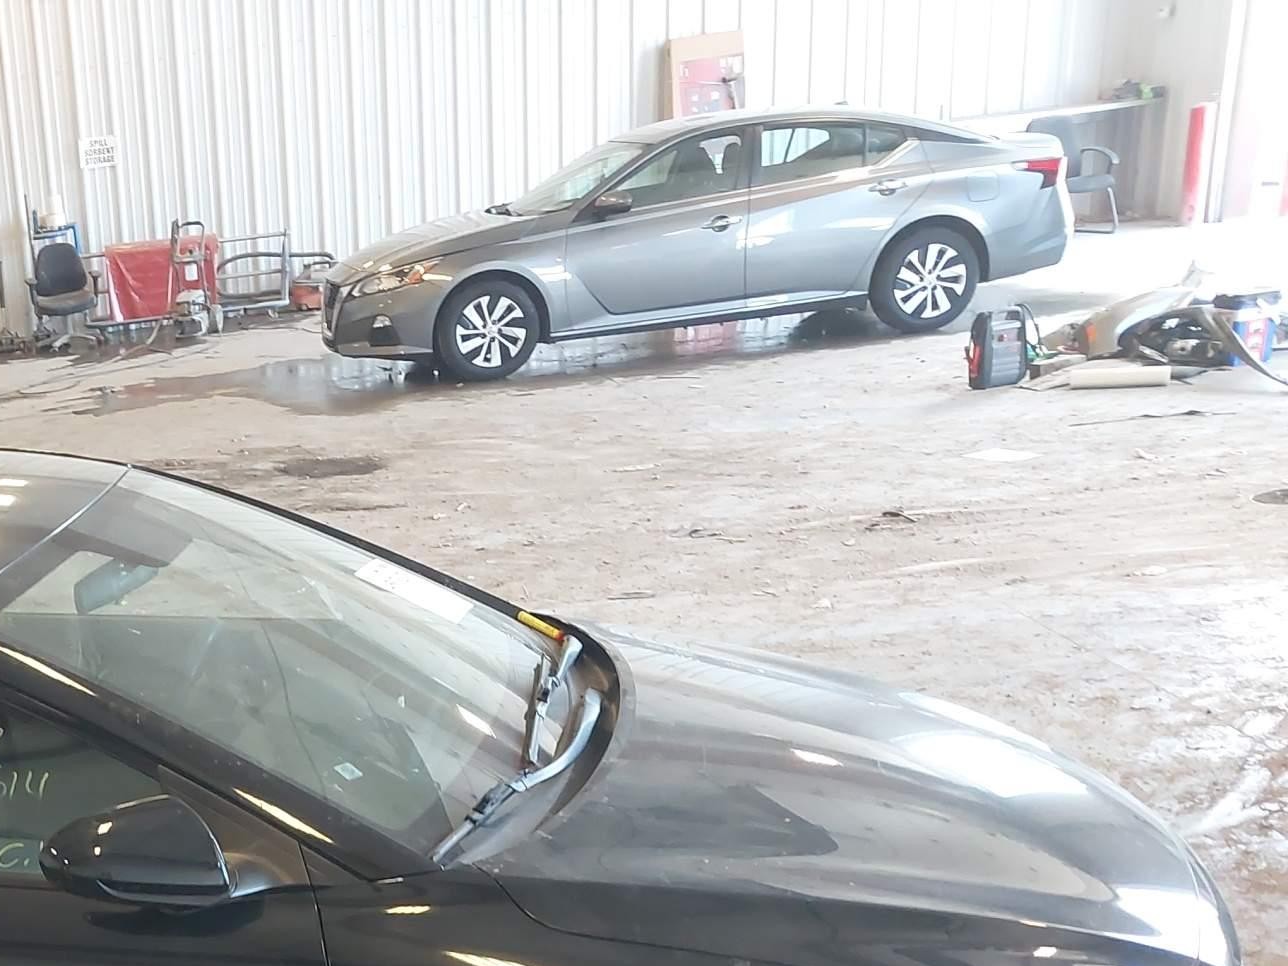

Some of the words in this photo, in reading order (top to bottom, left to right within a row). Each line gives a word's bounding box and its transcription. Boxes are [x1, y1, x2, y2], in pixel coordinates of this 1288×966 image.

[89, 139, 109, 148] SPILL
[84, 146, 115, 157] SORBENT
[84, 155, 116, 166] STORAGE
